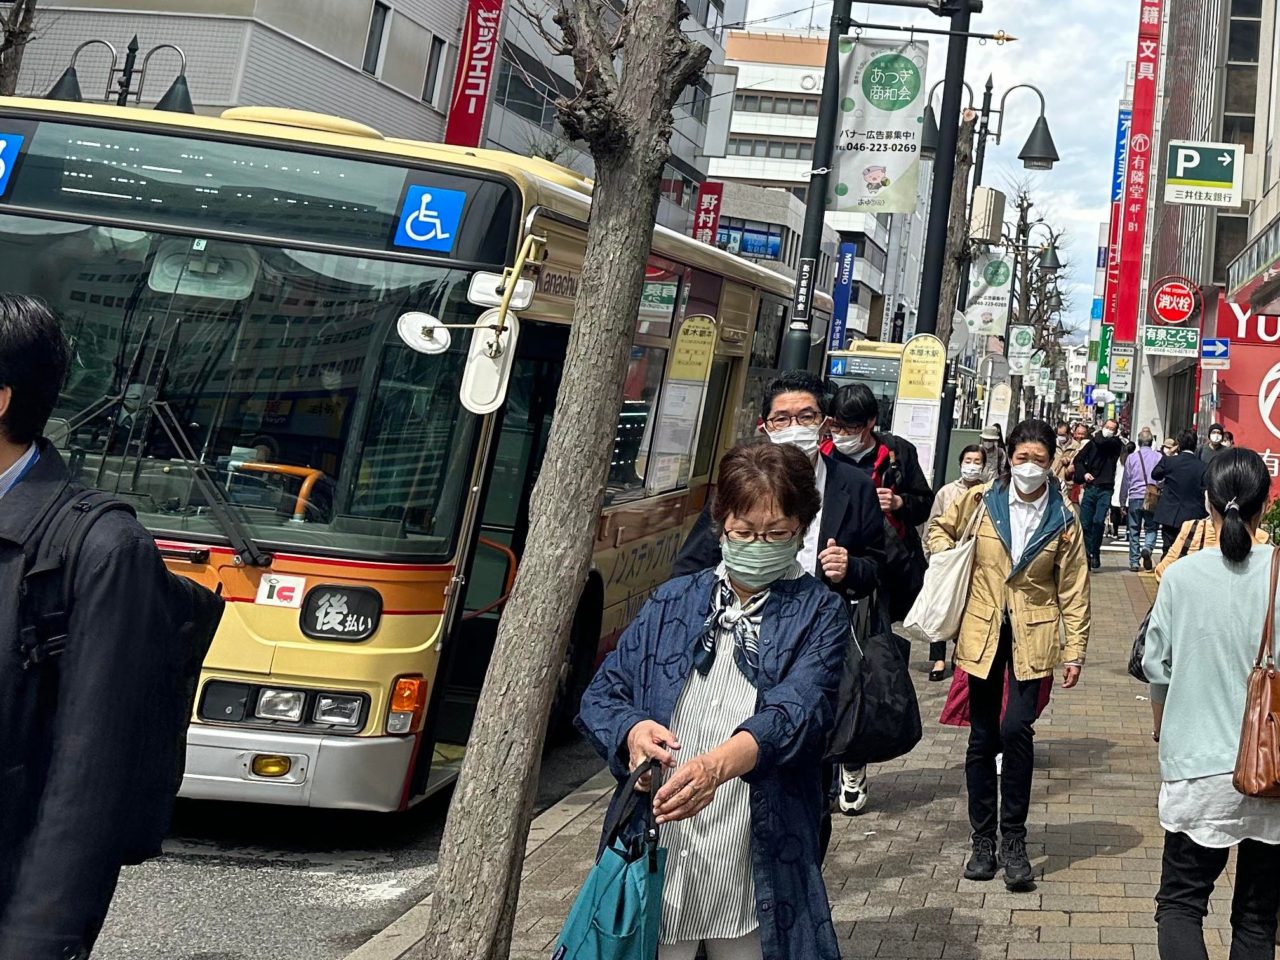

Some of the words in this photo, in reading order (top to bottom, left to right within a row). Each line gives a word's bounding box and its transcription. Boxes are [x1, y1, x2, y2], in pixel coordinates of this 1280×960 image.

[465, 8, 500, 115] ビッグエコー
[1137, 39, 1157, 81] 文具
[870, 68, 914, 84] あつぎ
[870, 85, 912, 101] 商和会
[846, 142, 917, 153] 046-223-0269
[1176, 148, 1200, 177] P
[1129, 155, 1147, 200] 有隣堂
[1174, 190, 1233, 203] 三井住友銀行
[841, 253, 853, 285] MIZUHO
[1158, 293, 1191, 312] 消火栓
[1146, 328, 1197, 342] 有泉こども
[1154, 341, 1188, 349] クリニック
[315, 592, 372, 632] 後払い
